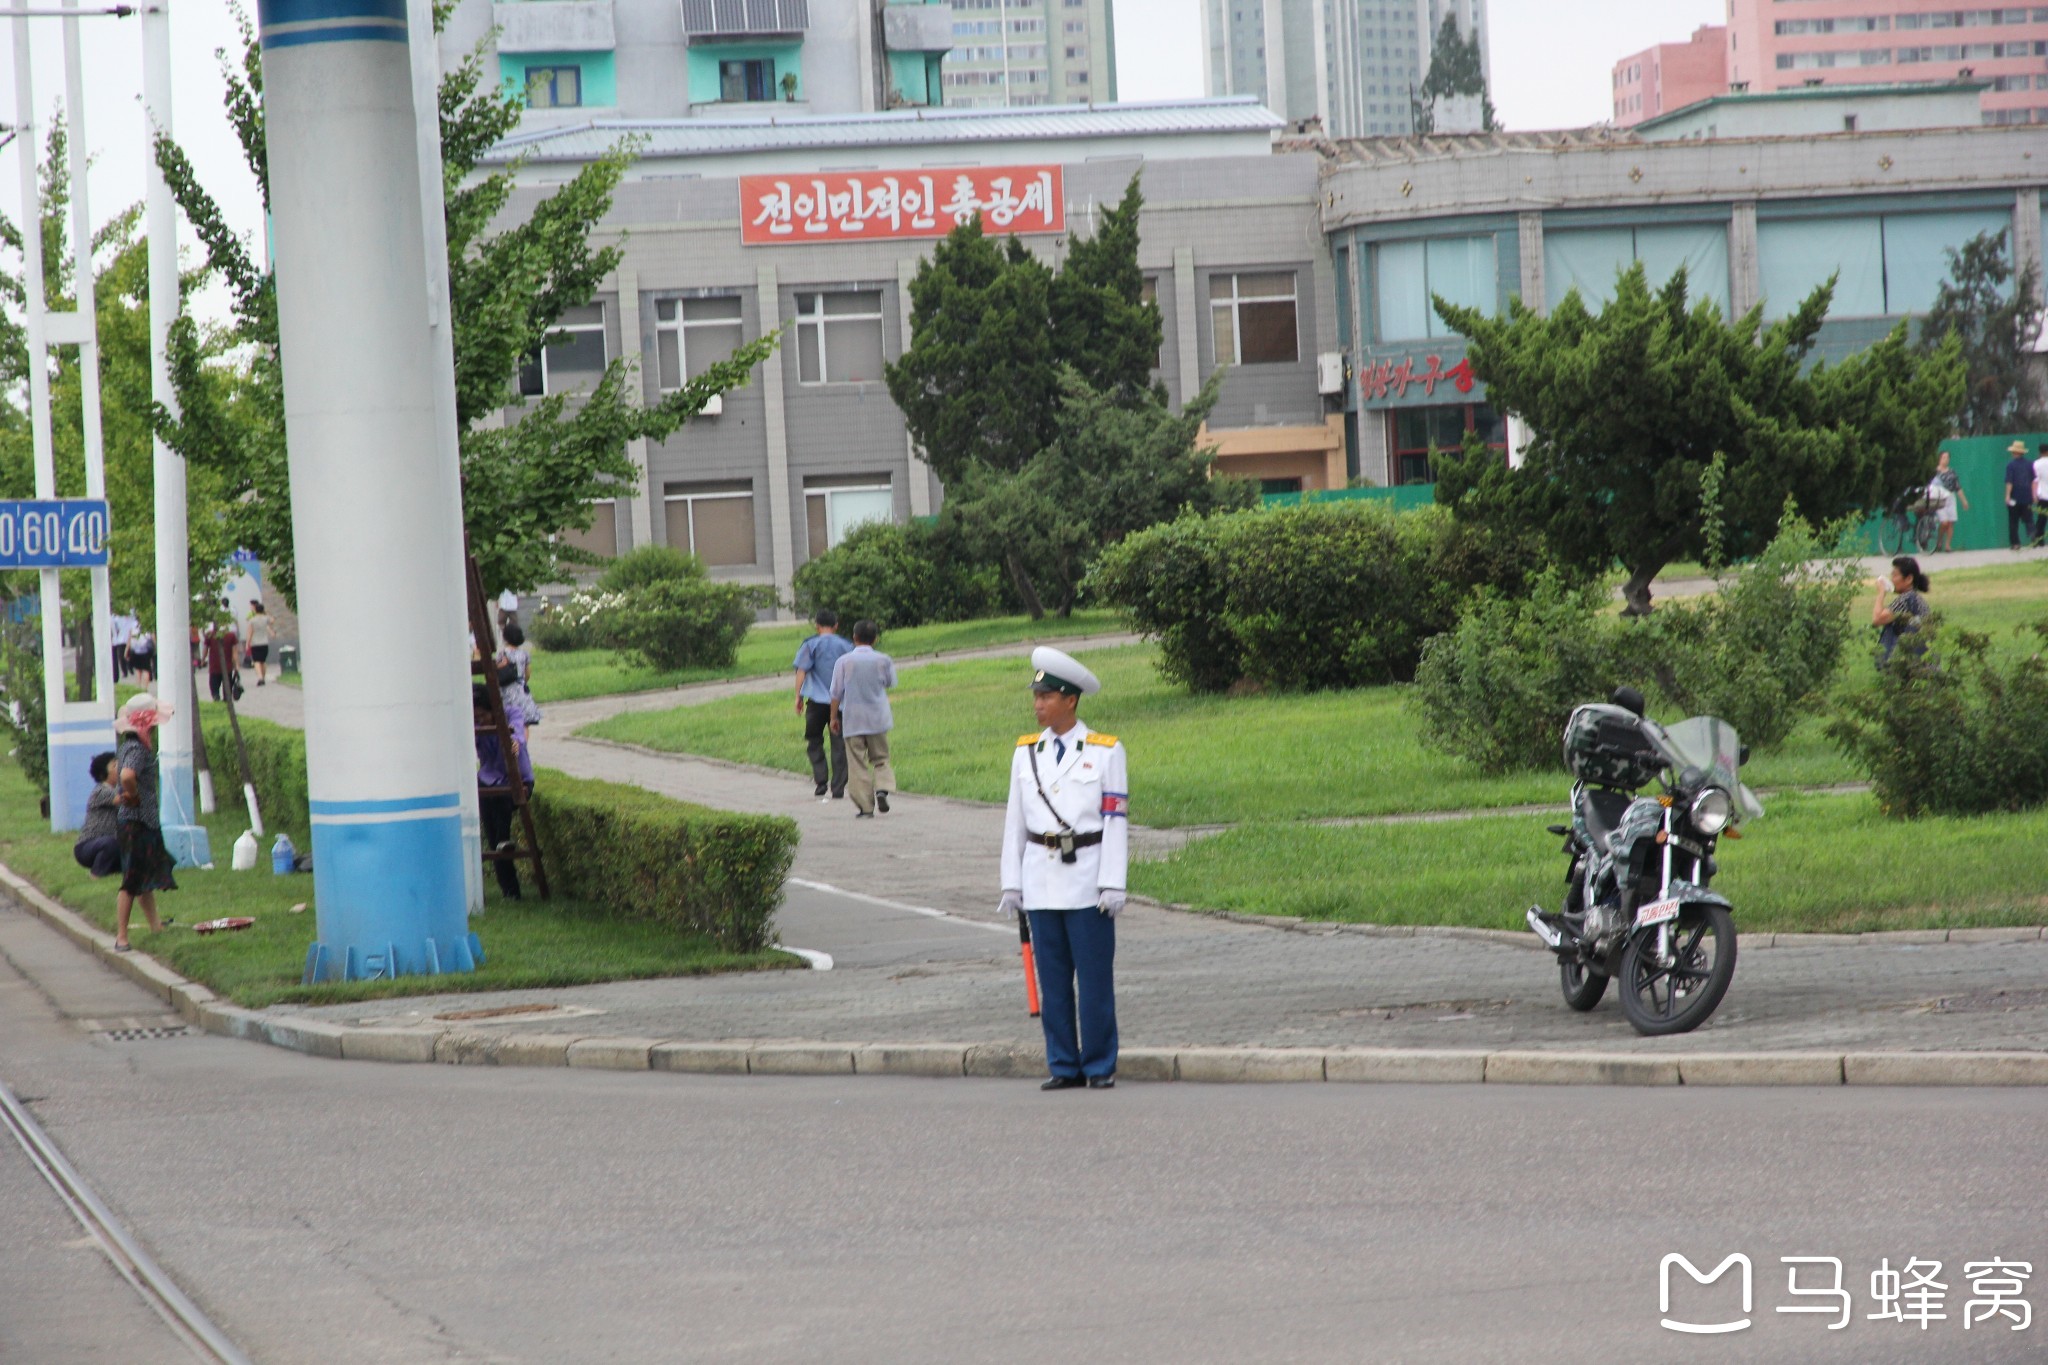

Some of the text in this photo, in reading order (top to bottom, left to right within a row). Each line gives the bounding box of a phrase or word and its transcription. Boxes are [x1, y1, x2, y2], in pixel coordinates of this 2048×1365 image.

[753, 171, 1054, 234] 전인민적인 총공세
[23, 511, 60, 555] 60
[68, 511, 103, 555] 40
